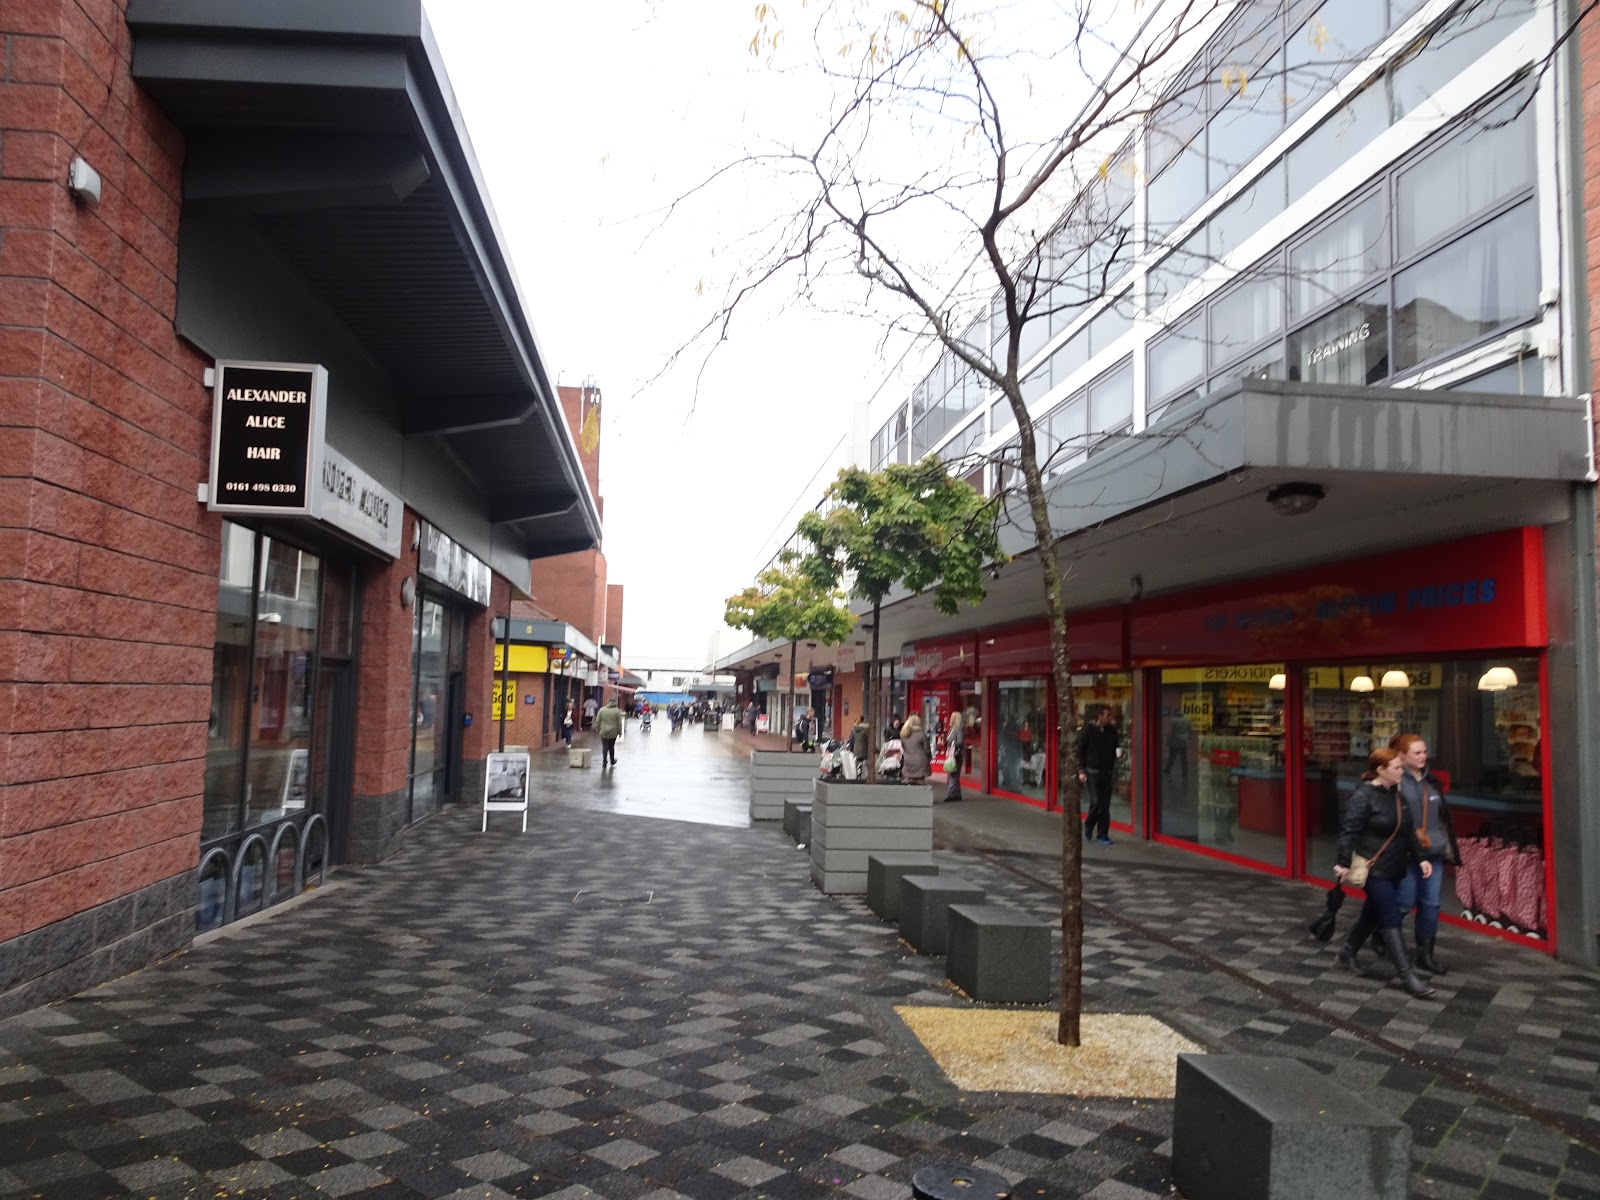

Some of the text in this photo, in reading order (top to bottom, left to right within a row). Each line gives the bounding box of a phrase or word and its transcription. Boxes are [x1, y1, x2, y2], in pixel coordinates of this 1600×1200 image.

[1305, 322, 1371, 367] TRAINING
[227, 388, 307, 404] ALEXANDER
[245, 415, 286, 429] ALICE
[246, 446, 281, 460] HAIR
[226, 482, 296, 493] 0161 498 0330
[1406, 578, 1497, 612] PRICES
[492, 692, 514, 704] God
